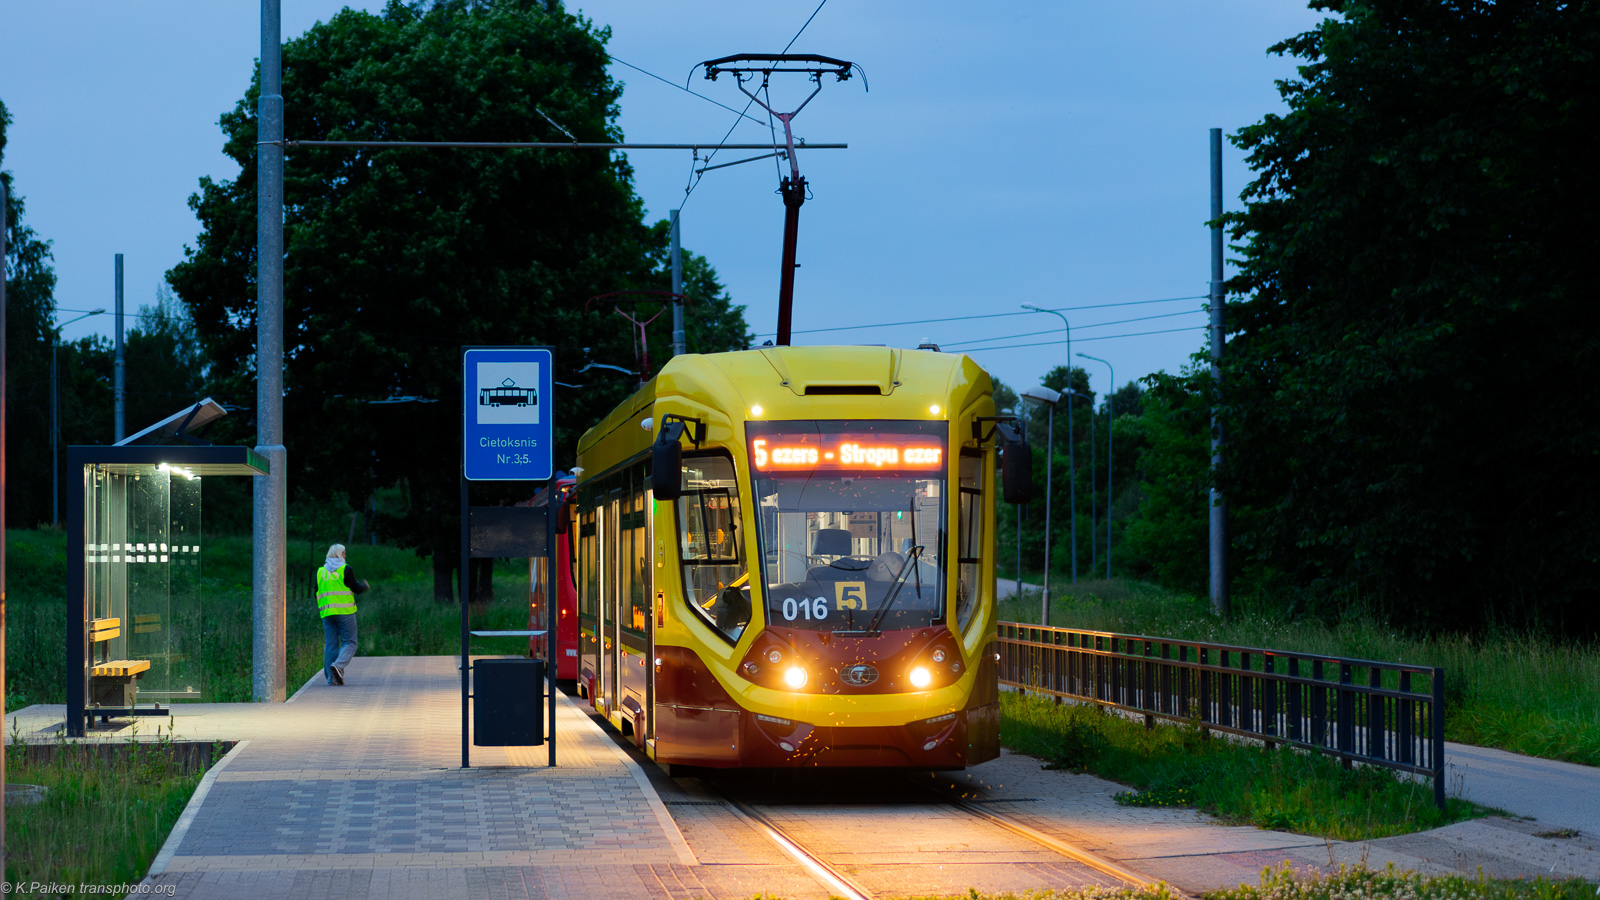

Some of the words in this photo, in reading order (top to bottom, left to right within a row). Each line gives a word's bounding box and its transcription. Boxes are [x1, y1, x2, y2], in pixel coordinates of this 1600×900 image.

[480, 437, 537, 447] Cietoksnis
[754, 440, 767, 466] 5
[772, 448, 818, 463] ezers
[840, 444, 898, 466] Stropu
[904, 448, 942, 463] ezer
[782, 596, 828, 620] 016
[842, 586, 863, 610] 5
